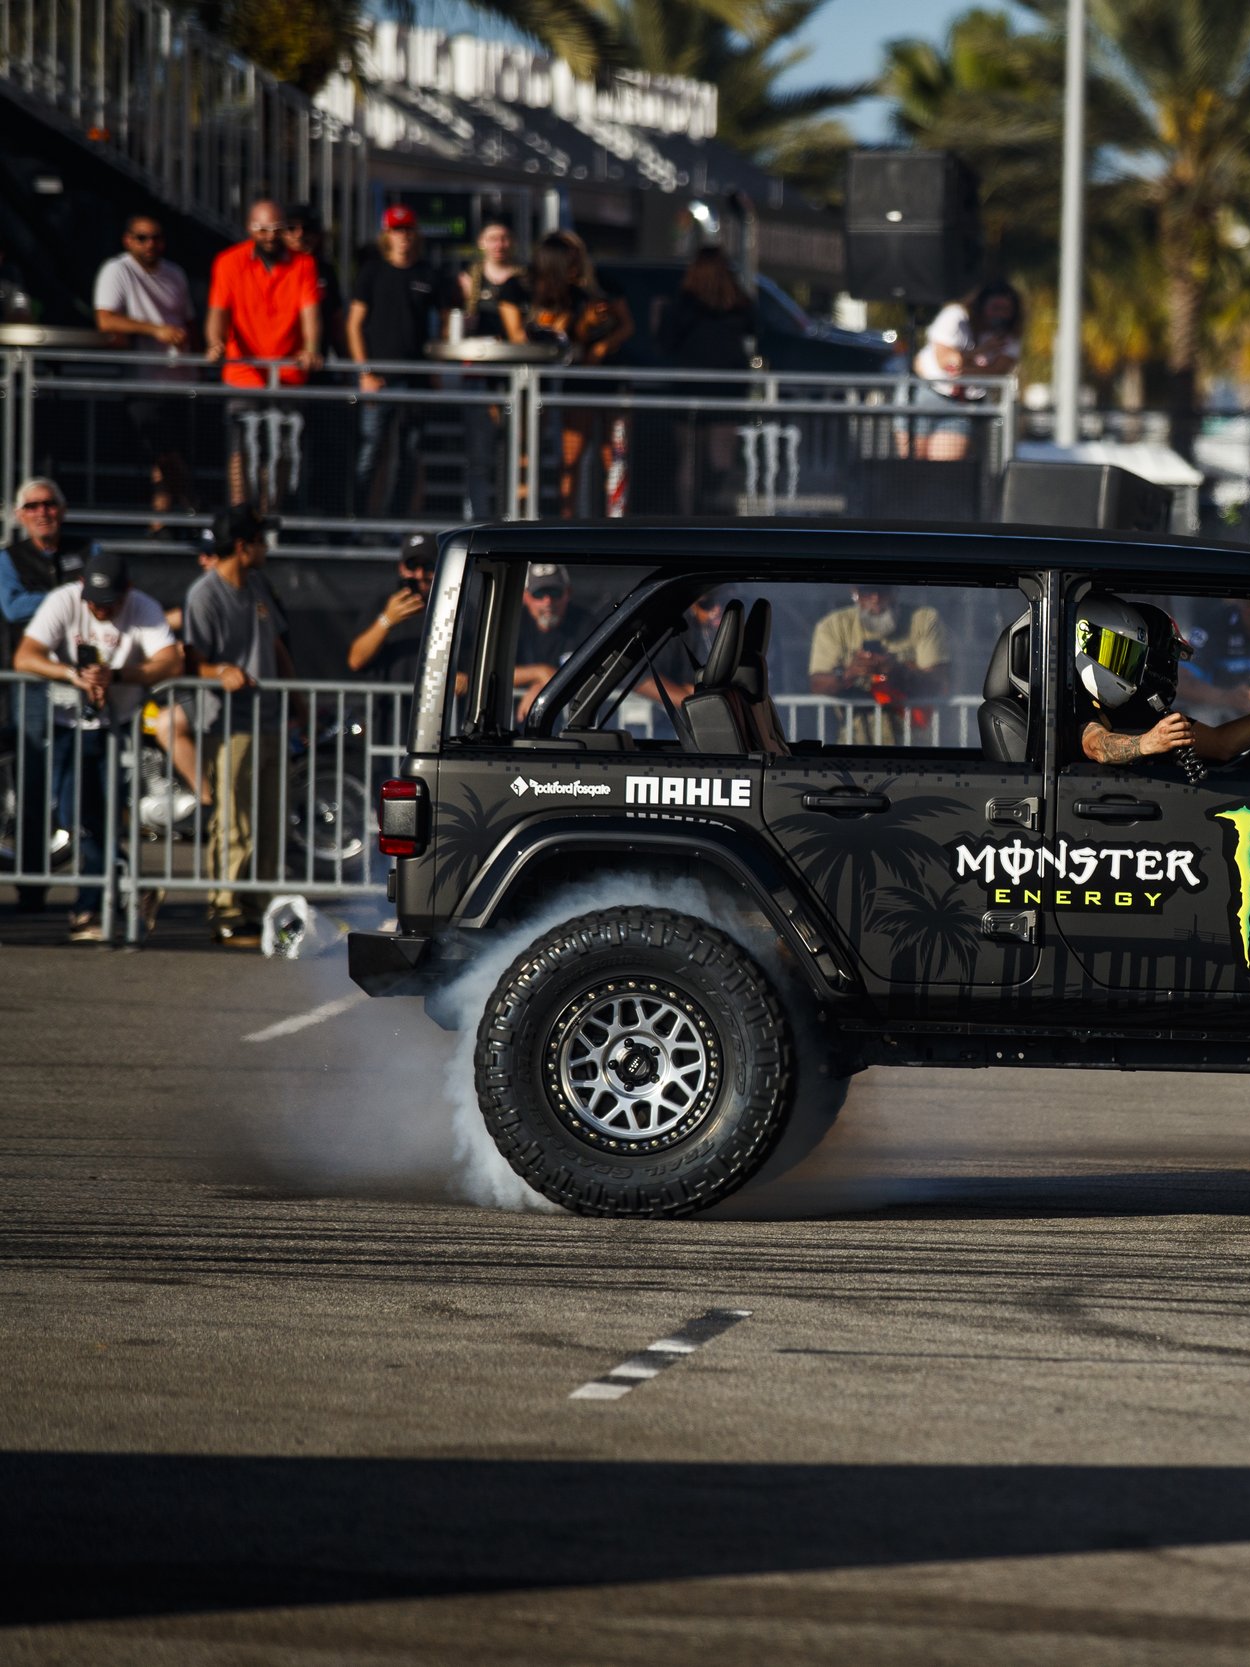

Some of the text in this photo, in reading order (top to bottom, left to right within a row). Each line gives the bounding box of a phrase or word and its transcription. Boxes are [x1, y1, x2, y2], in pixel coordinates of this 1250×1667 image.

[529, 778, 611, 798] Rockford Fosgate
[625, 776, 751, 807] MAHLE
[956, 838, 1201, 886] MONSTER
[994, 889, 1162, 907] ENERGY
